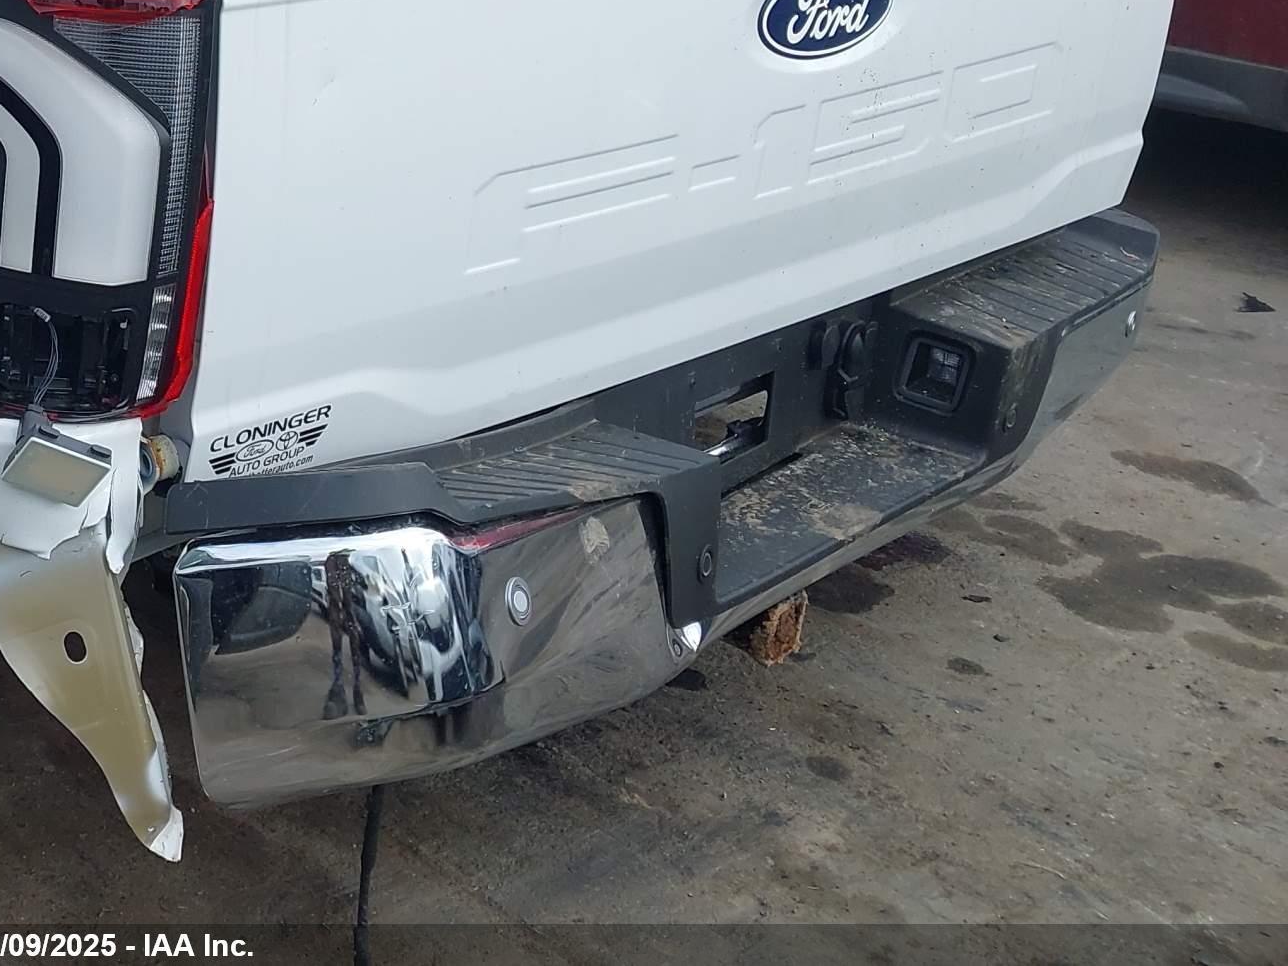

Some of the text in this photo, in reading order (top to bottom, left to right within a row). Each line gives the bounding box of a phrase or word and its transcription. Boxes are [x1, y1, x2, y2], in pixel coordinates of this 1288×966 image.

[463, 42, 1064, 275] F-150
[210, 404, 332, 453] CLONINGER
[229, 445, 306, 478] AUTO GROUP
[243, 443, 268, 459] Ford
